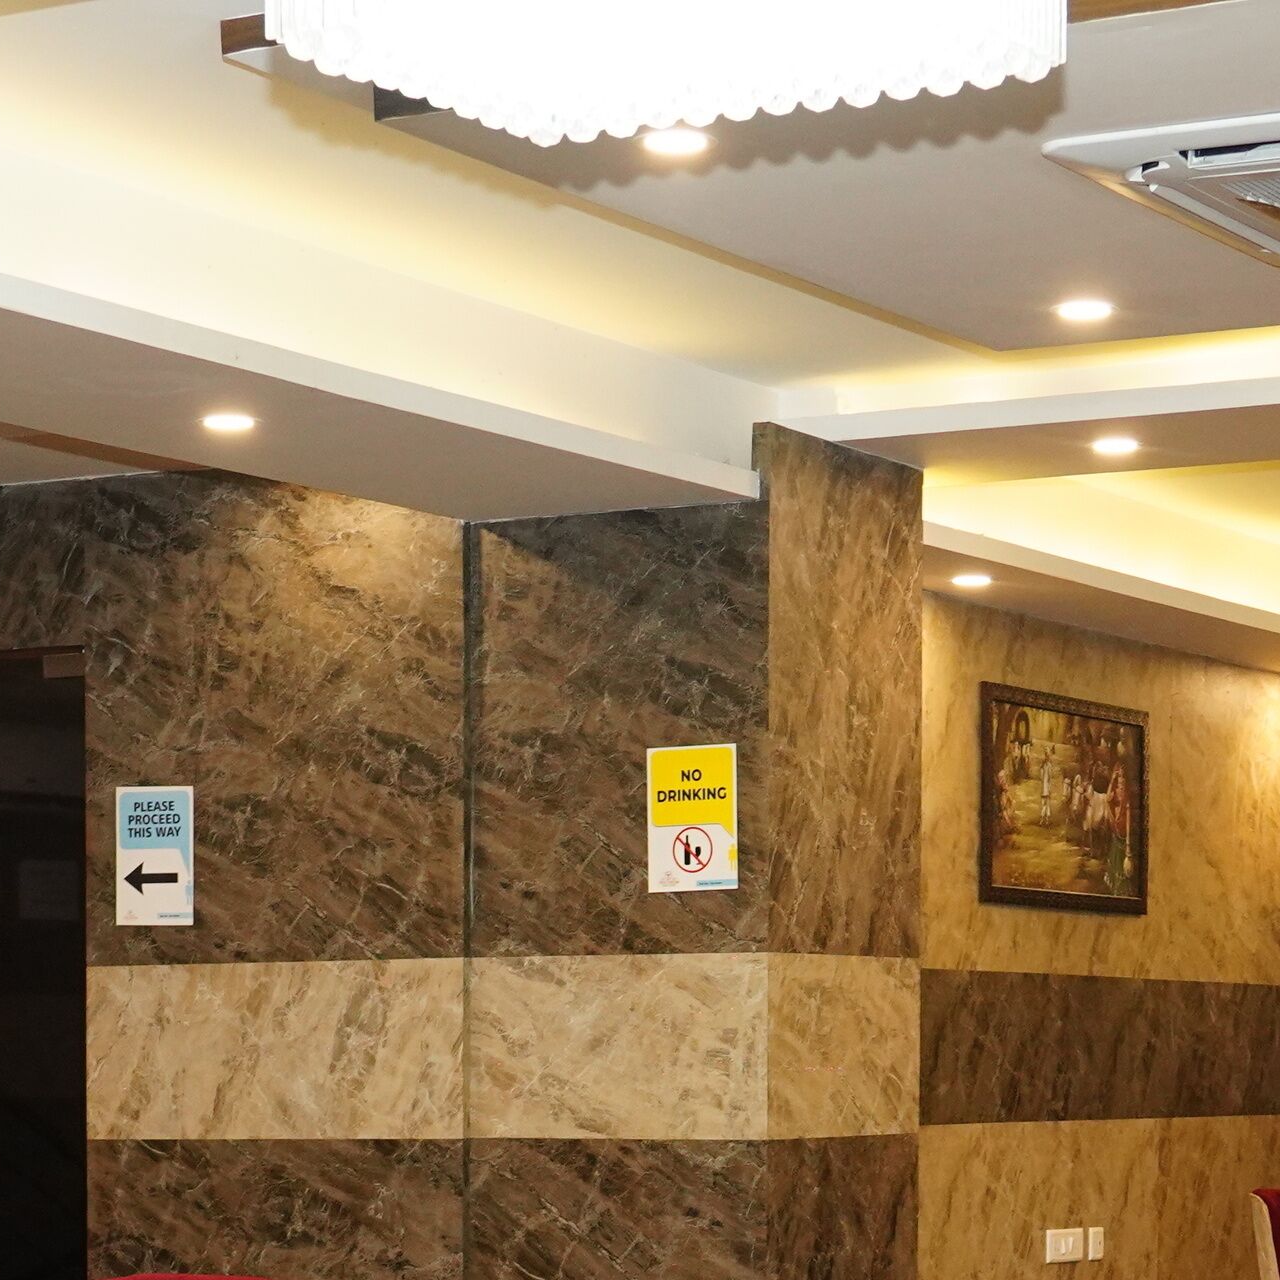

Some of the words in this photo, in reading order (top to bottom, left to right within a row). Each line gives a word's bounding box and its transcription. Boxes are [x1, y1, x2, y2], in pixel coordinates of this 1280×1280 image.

[681, 769, 702, 782] NO
[657, 787, 727, 803] DRINKING
[133, 800, 175, 812] PLEASE
[128, 813, 181, 825] PROCEED
[128, 827, 152, 838] THIS
[155, 826, 182, 837] WAY
